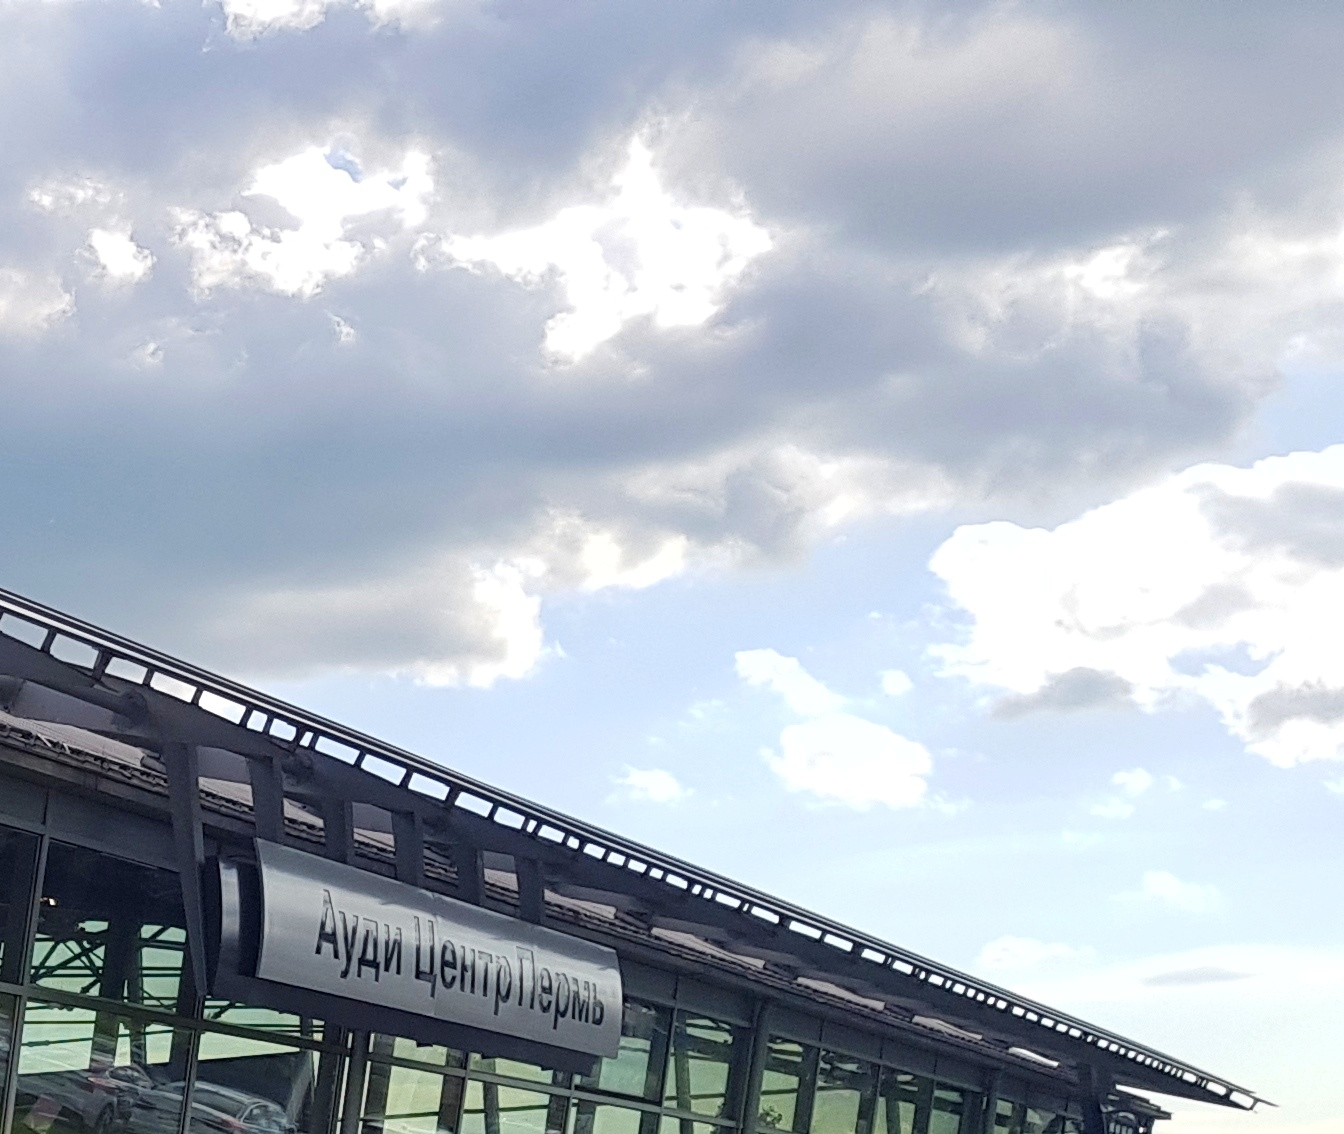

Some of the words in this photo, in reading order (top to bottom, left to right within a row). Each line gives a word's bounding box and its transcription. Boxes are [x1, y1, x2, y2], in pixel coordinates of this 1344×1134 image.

[315, 889, 402, 982] Ауди
[413, 916, 512, 1016] Центр
[516, 946, 605, 1030] Пермь
